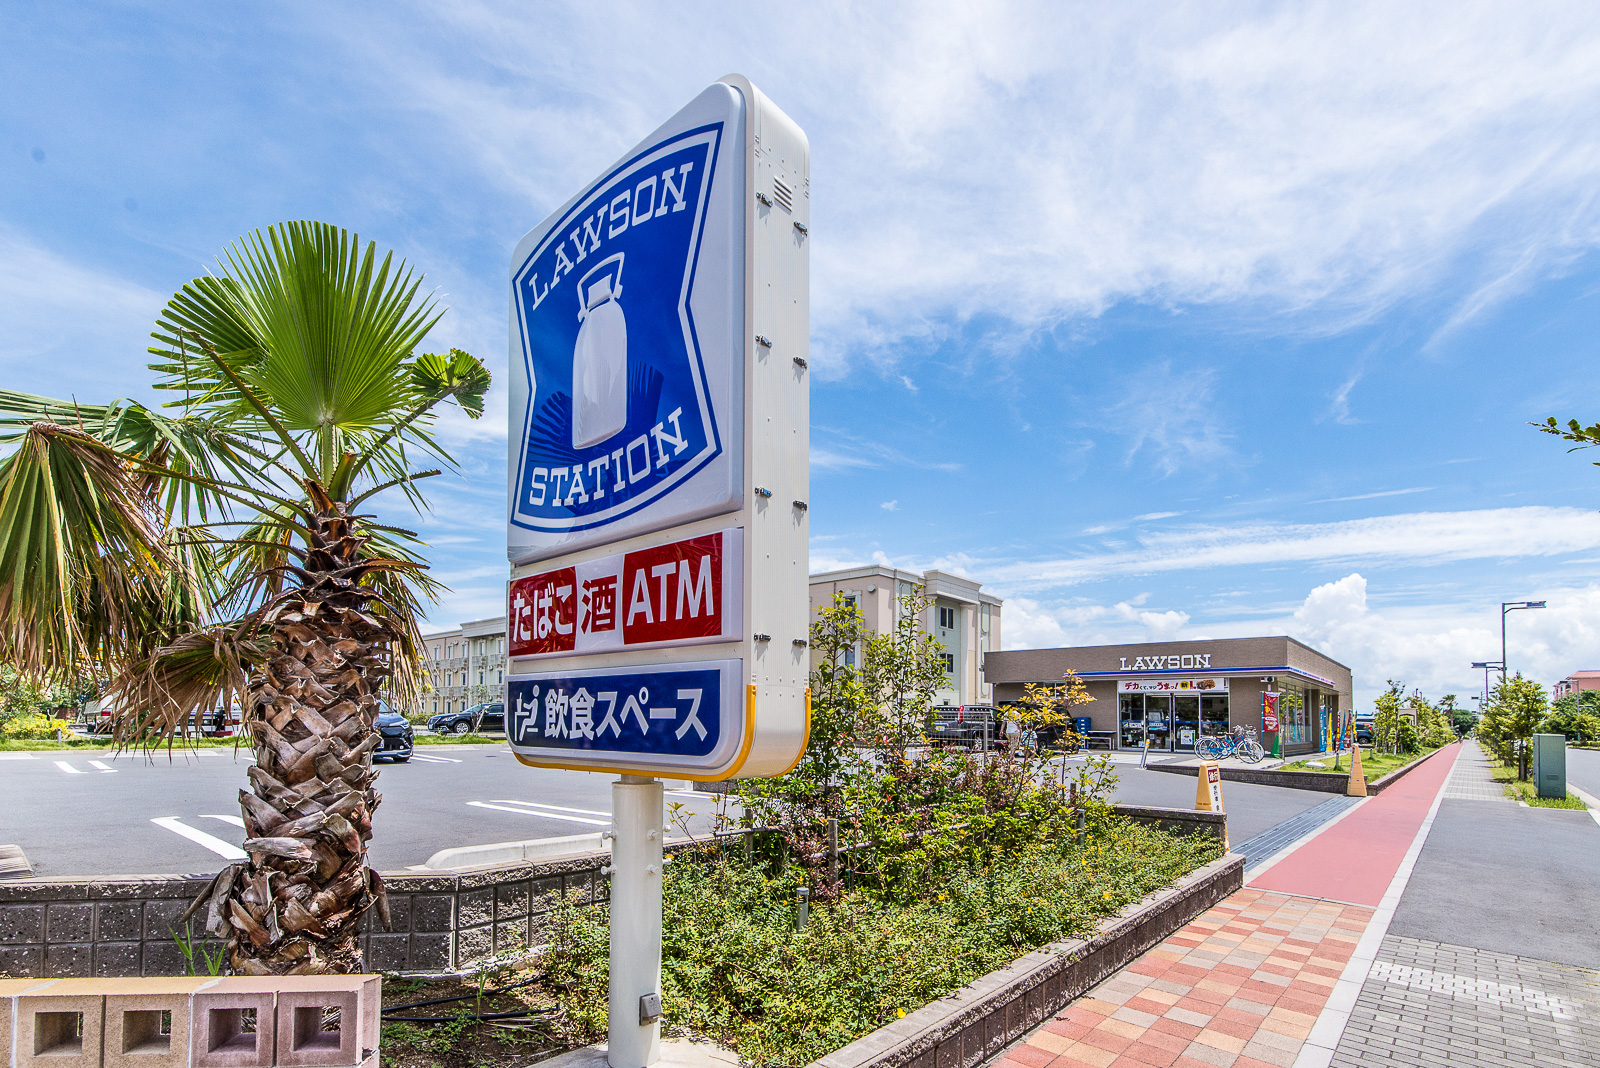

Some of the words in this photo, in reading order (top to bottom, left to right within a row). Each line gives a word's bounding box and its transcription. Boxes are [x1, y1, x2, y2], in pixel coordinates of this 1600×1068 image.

[529, 161, 694, 311] LAWSON
[528, 407, 689, 508] STATION
[513, 583, 573, 642] たばこ
[581, 575, 618, 635] 酒
[627, 555, 714, 626] ATM
[1120, 654, 1211, 670] LAWSON
[545, 686, 707, 741] 飲食スペース
